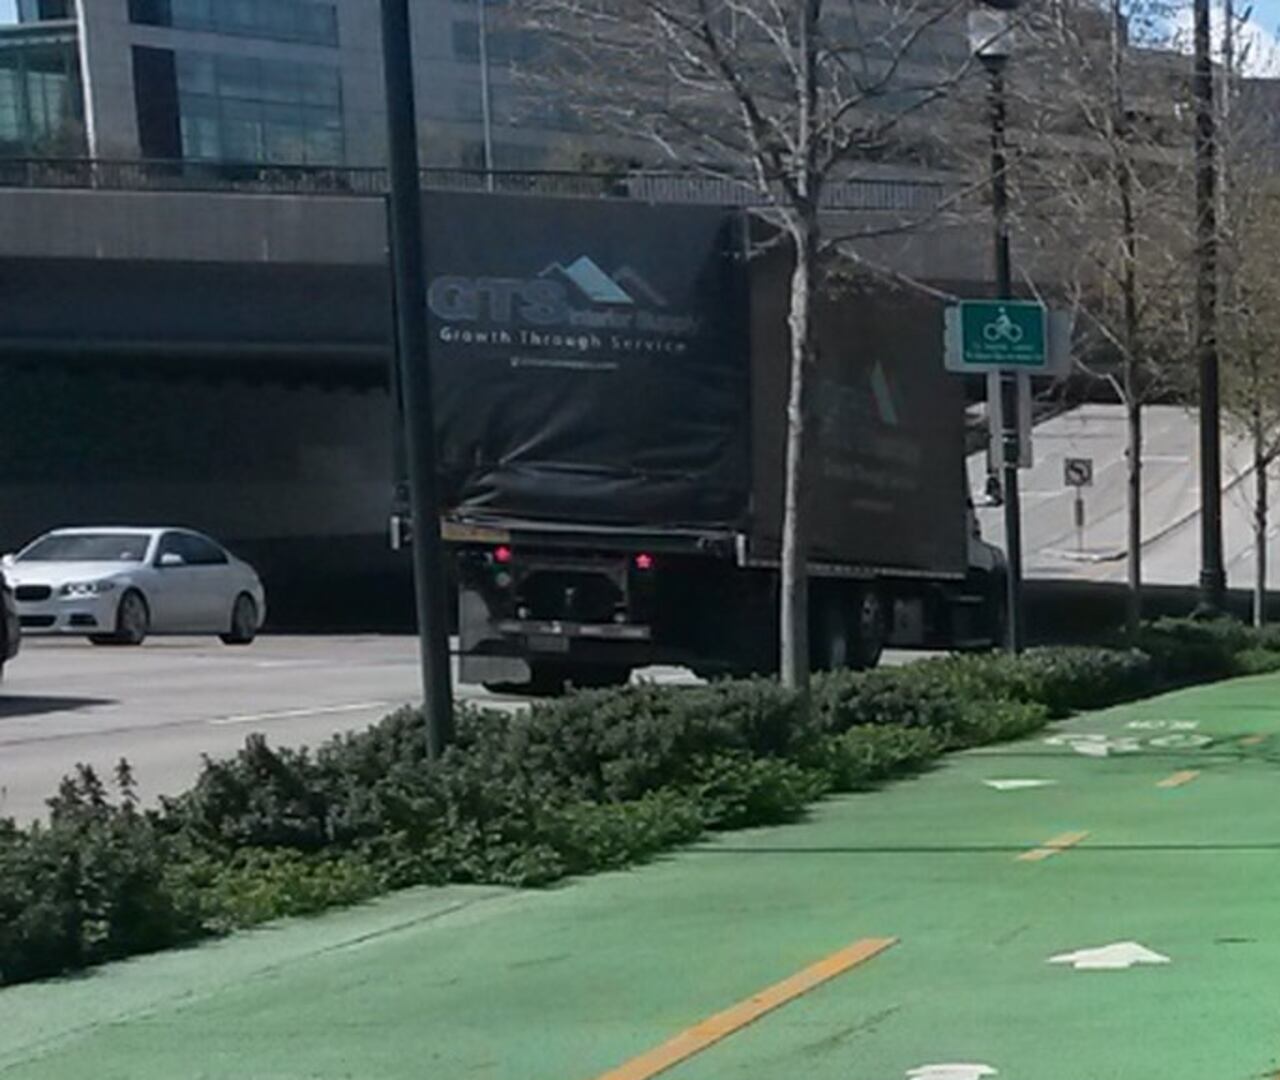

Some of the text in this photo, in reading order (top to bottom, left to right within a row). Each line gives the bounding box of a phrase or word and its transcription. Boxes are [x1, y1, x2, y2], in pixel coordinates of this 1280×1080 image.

[427, 276, 570, 325] GTS
[439, 325, 687, 352] Growth Through Service
